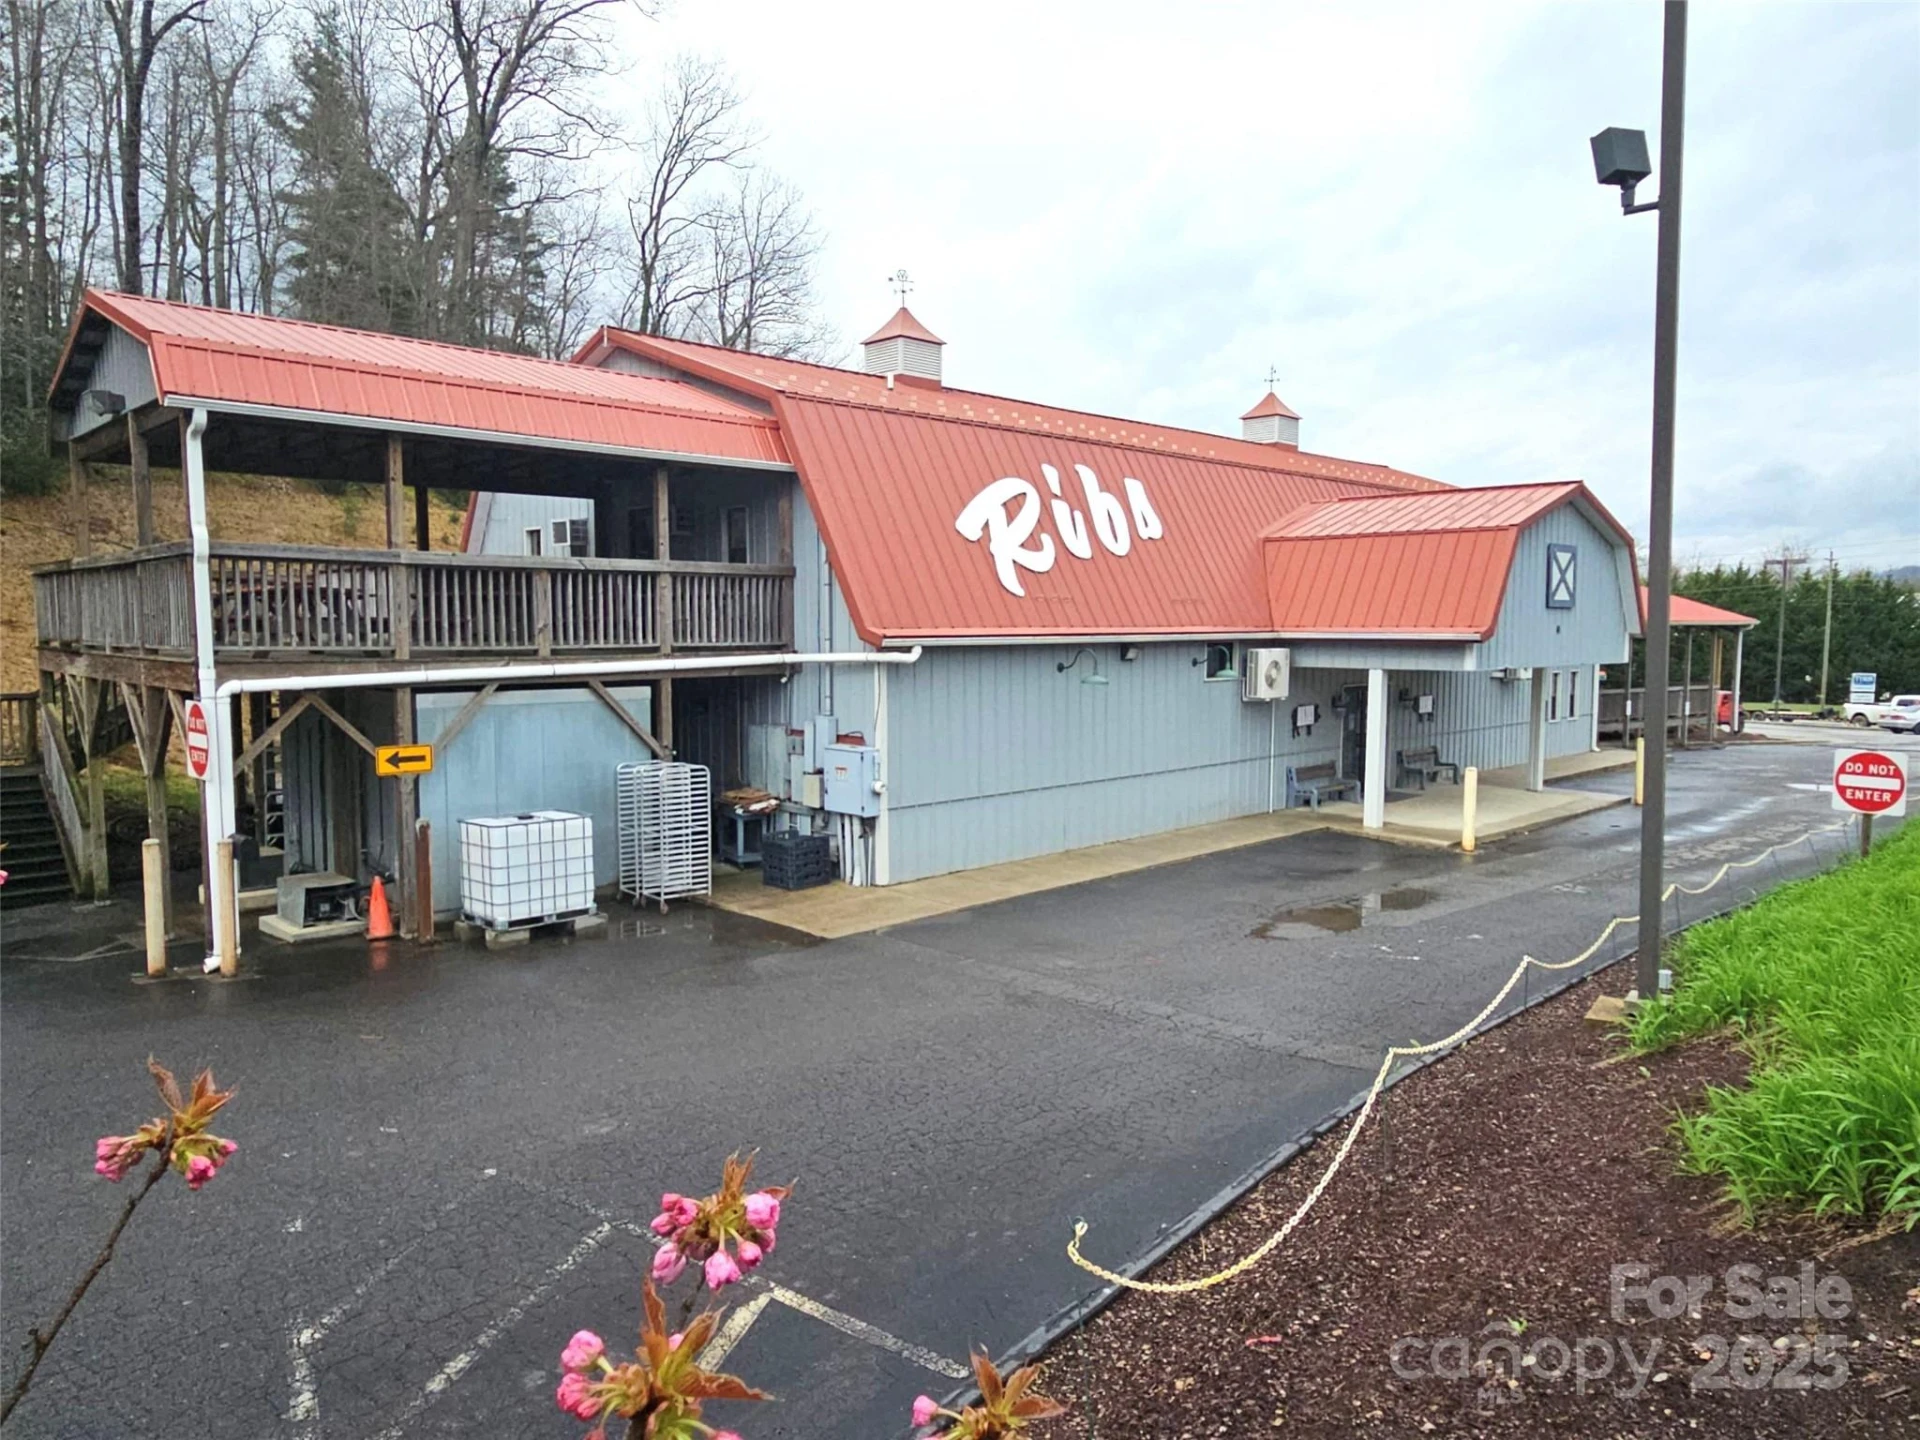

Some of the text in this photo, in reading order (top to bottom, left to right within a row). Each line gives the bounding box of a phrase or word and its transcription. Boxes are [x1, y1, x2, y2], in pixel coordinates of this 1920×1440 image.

[955, 463, 1164, 597] Ribs
[1845, 762, 1896, 776] DO NOT
[1845, 788, 1891, 803] ENTER
